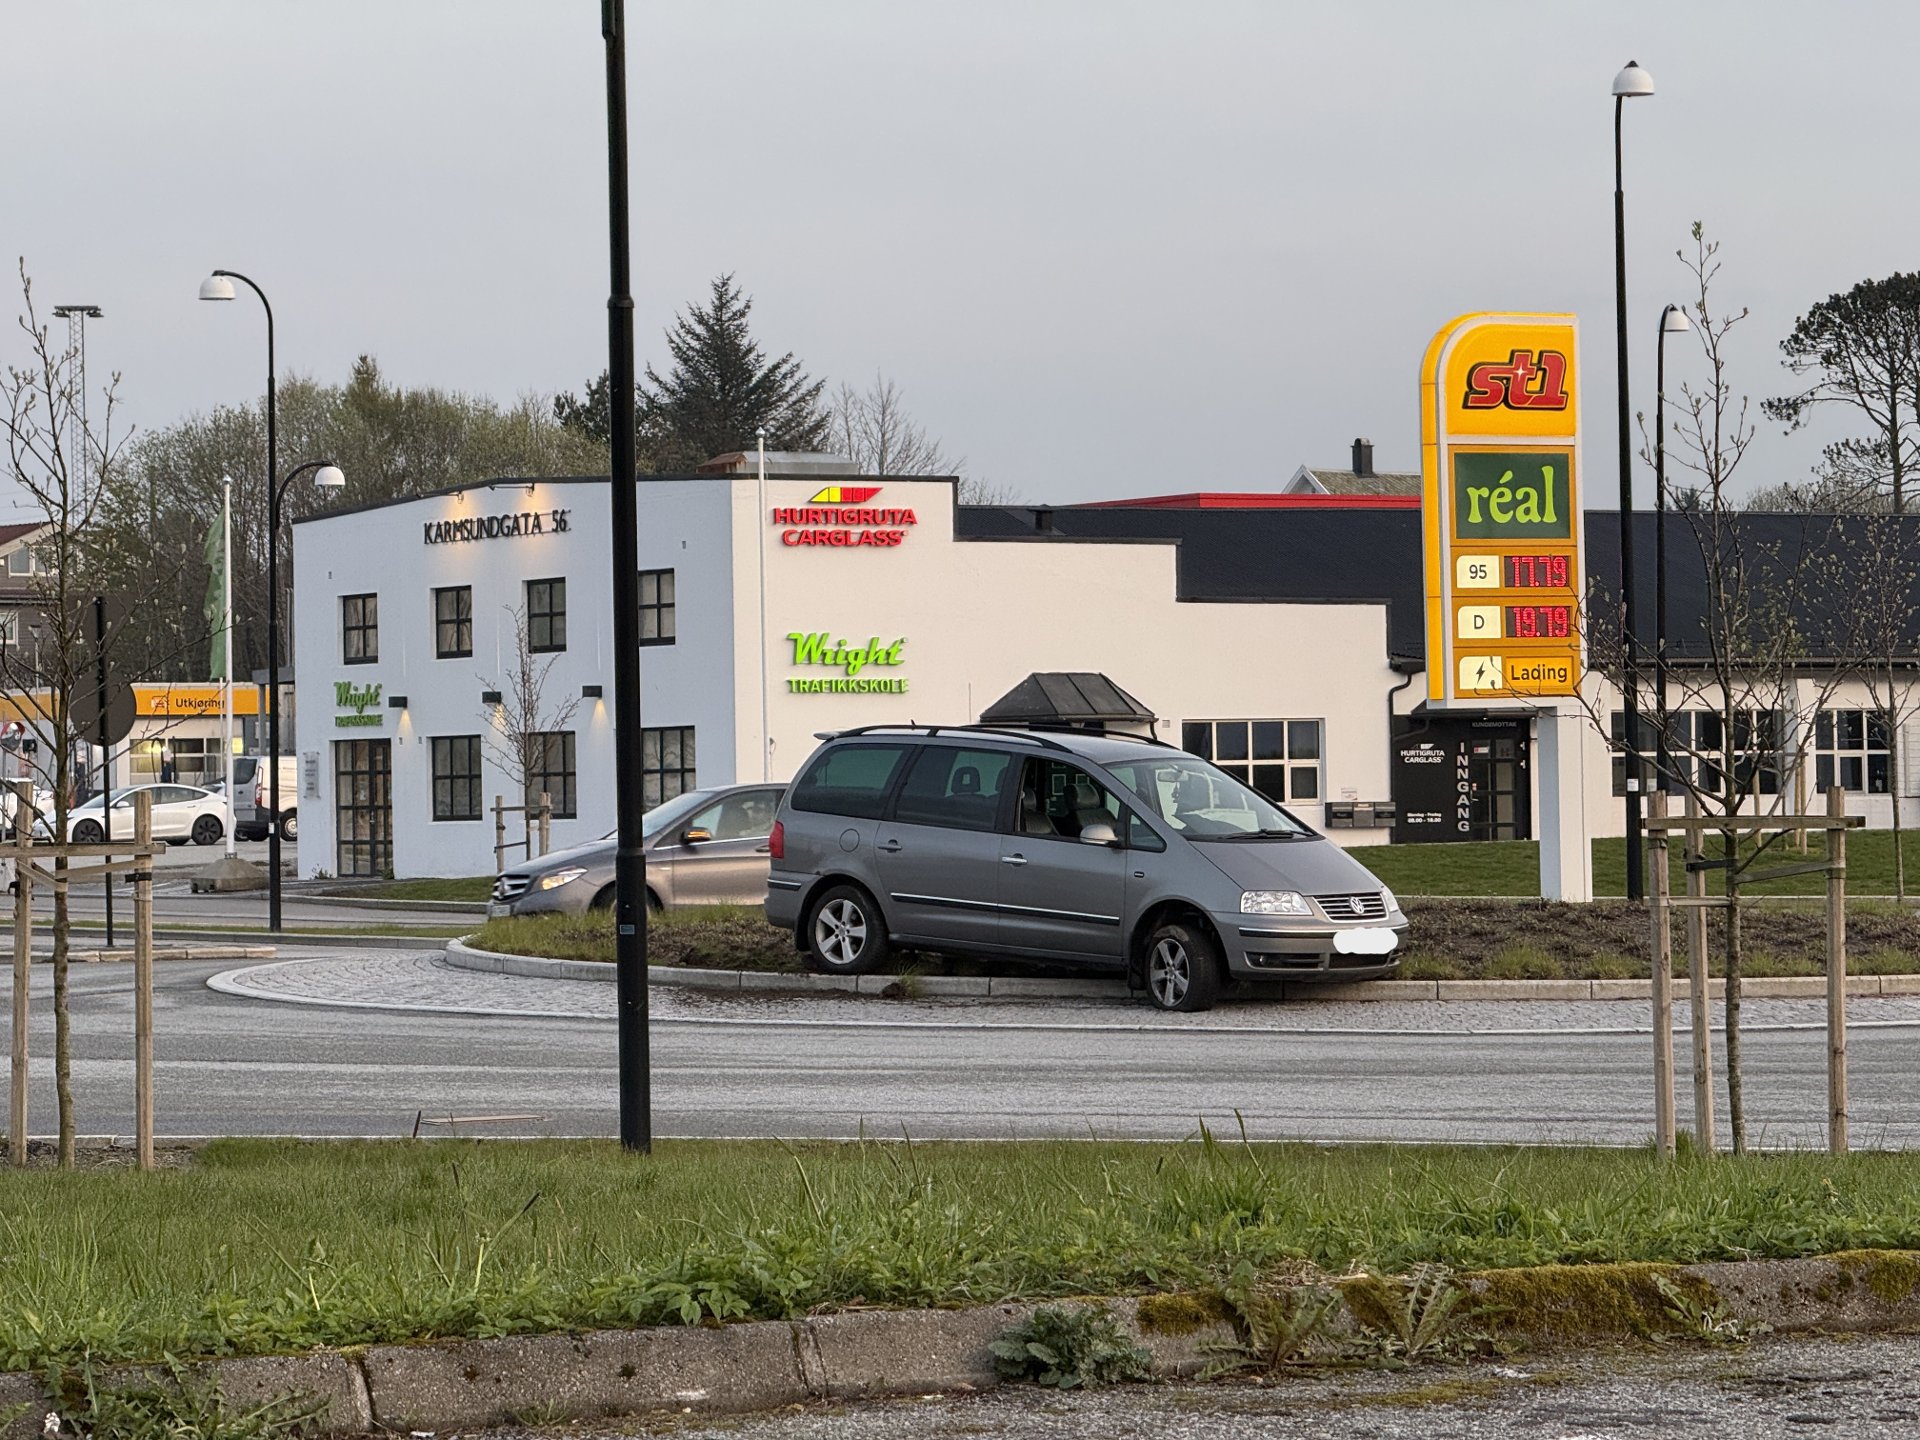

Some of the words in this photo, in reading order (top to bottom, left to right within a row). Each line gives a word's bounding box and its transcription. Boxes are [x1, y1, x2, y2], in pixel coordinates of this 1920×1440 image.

[1462, 349, 1568, 411] st1
[1466, 465, 1557, 523] réal
[424, 512, 542, 544] KARMSUNDGATA
[552, 509, 567, 533] 56
[773, 508, 917, 525] HURTIGRUTA
[782, 529, 904, 547] CARGLASS
[1469, 564, 1487, 580] 95
[1511, 557, 1567, 587] 17.79
[1473, 614, 1485, 630] D
[1513, 607, 1568, 637] 19.79
[787, 632, 907, 676] Wright
[787, 678, 909, 694] TRAFIKKSKOLE
[1510, 664, 1568, 683] Lading
[1456, 742, 1470, 832] INNGANG
